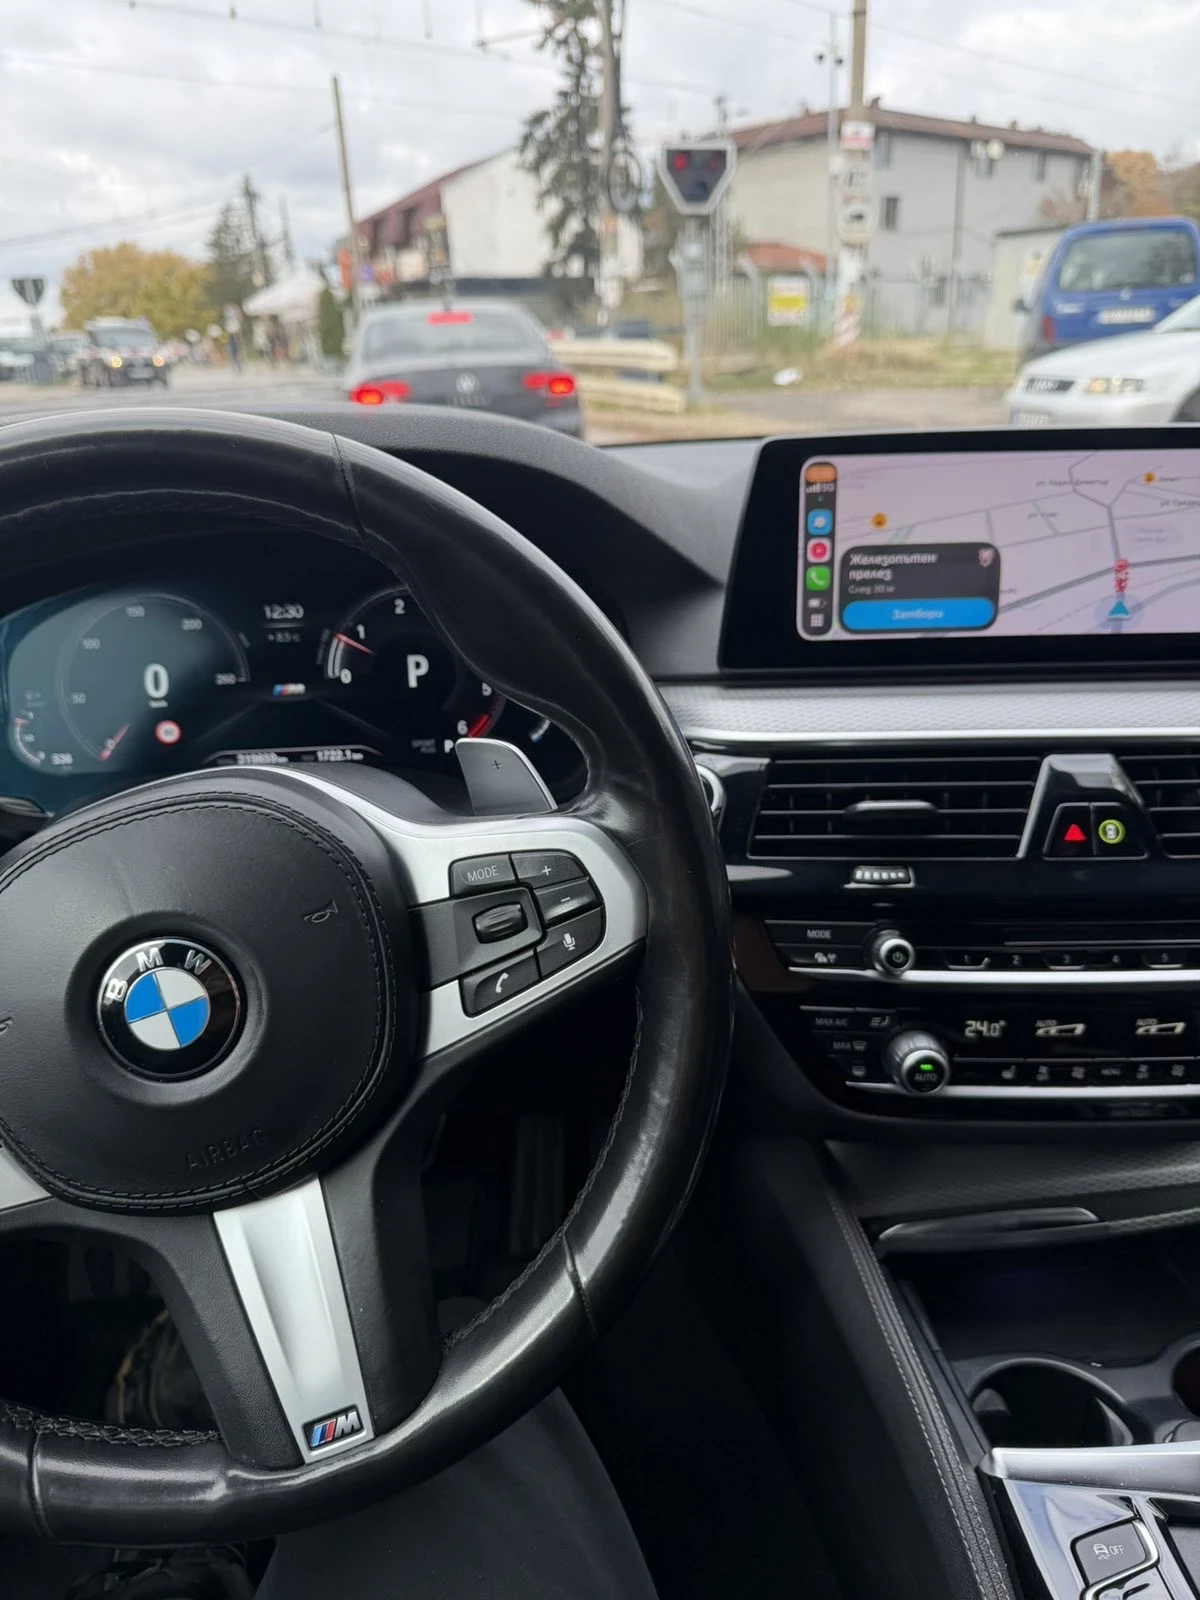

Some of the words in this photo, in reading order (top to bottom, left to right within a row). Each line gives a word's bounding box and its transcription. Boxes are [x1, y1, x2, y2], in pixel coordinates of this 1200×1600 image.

[264, 603, 304, 619] 12:30
[394, 598, 405, 614] 2
[356, 624, 365, 639] 1
[340, 668, 352, 684] 0
[407, 654, 429, 688] P
[144, 663, 169, 698] 0
[457, 720, 468, 735] 6
[444, 739, 454, 754] P
[467, 865, 498, 882] MODE
[807, 929, 832, 939] MODE
[104, 947, 212, 1003] BMW
[815, 1017, 833, 1026] MAX
[1035, 1019, 1058, 1028] AUTO
[1135, 1018, 1158, 1026] AUTO
[914, 1072, 937, 1082] AUTO
[186, 1129, 267, 1169] AIRBAG
[1109, 1544, 1125, 1555] OFF
